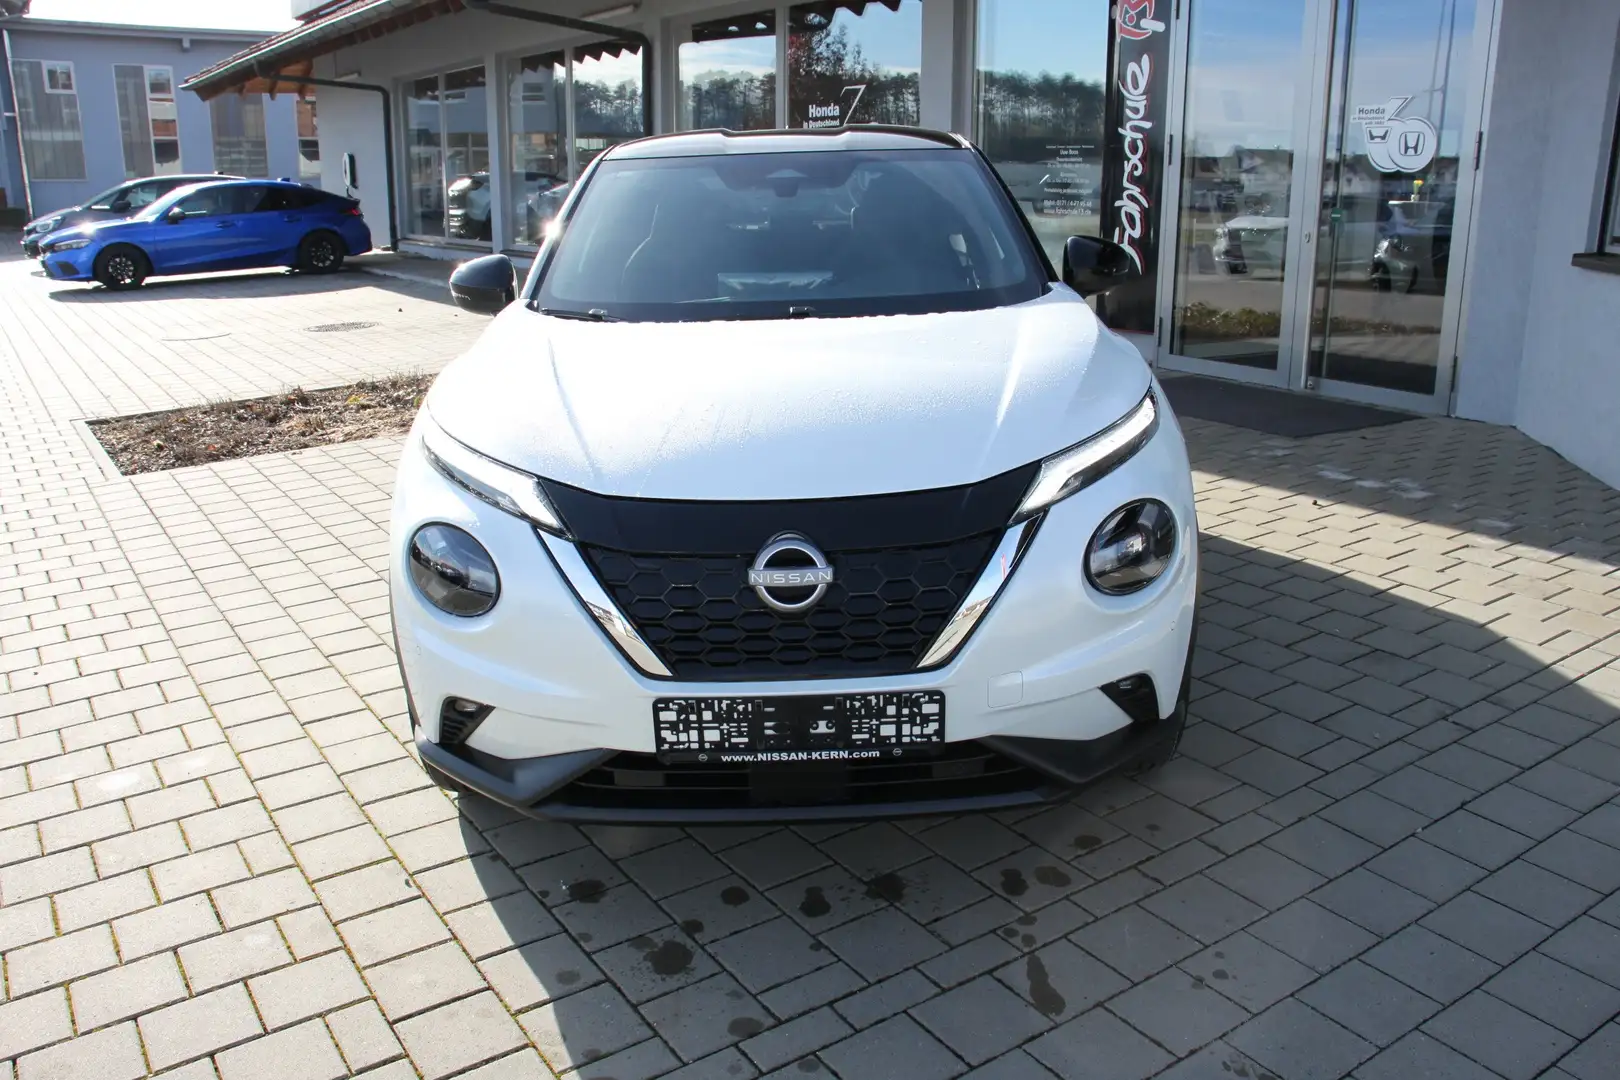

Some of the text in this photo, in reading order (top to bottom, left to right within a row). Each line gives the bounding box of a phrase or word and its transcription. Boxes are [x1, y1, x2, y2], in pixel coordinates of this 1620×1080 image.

[808, 102, 840, 118] Honda
[1358, 106, 1386, 115] Honda
[808, 118, 840, 129] Deutschland
[1113, 53, 1153, 276] Fahrschule
[751, 570, 831, 584] NISSAN
[720, 749, 880, 763] www.NISSAN-KERN.com
